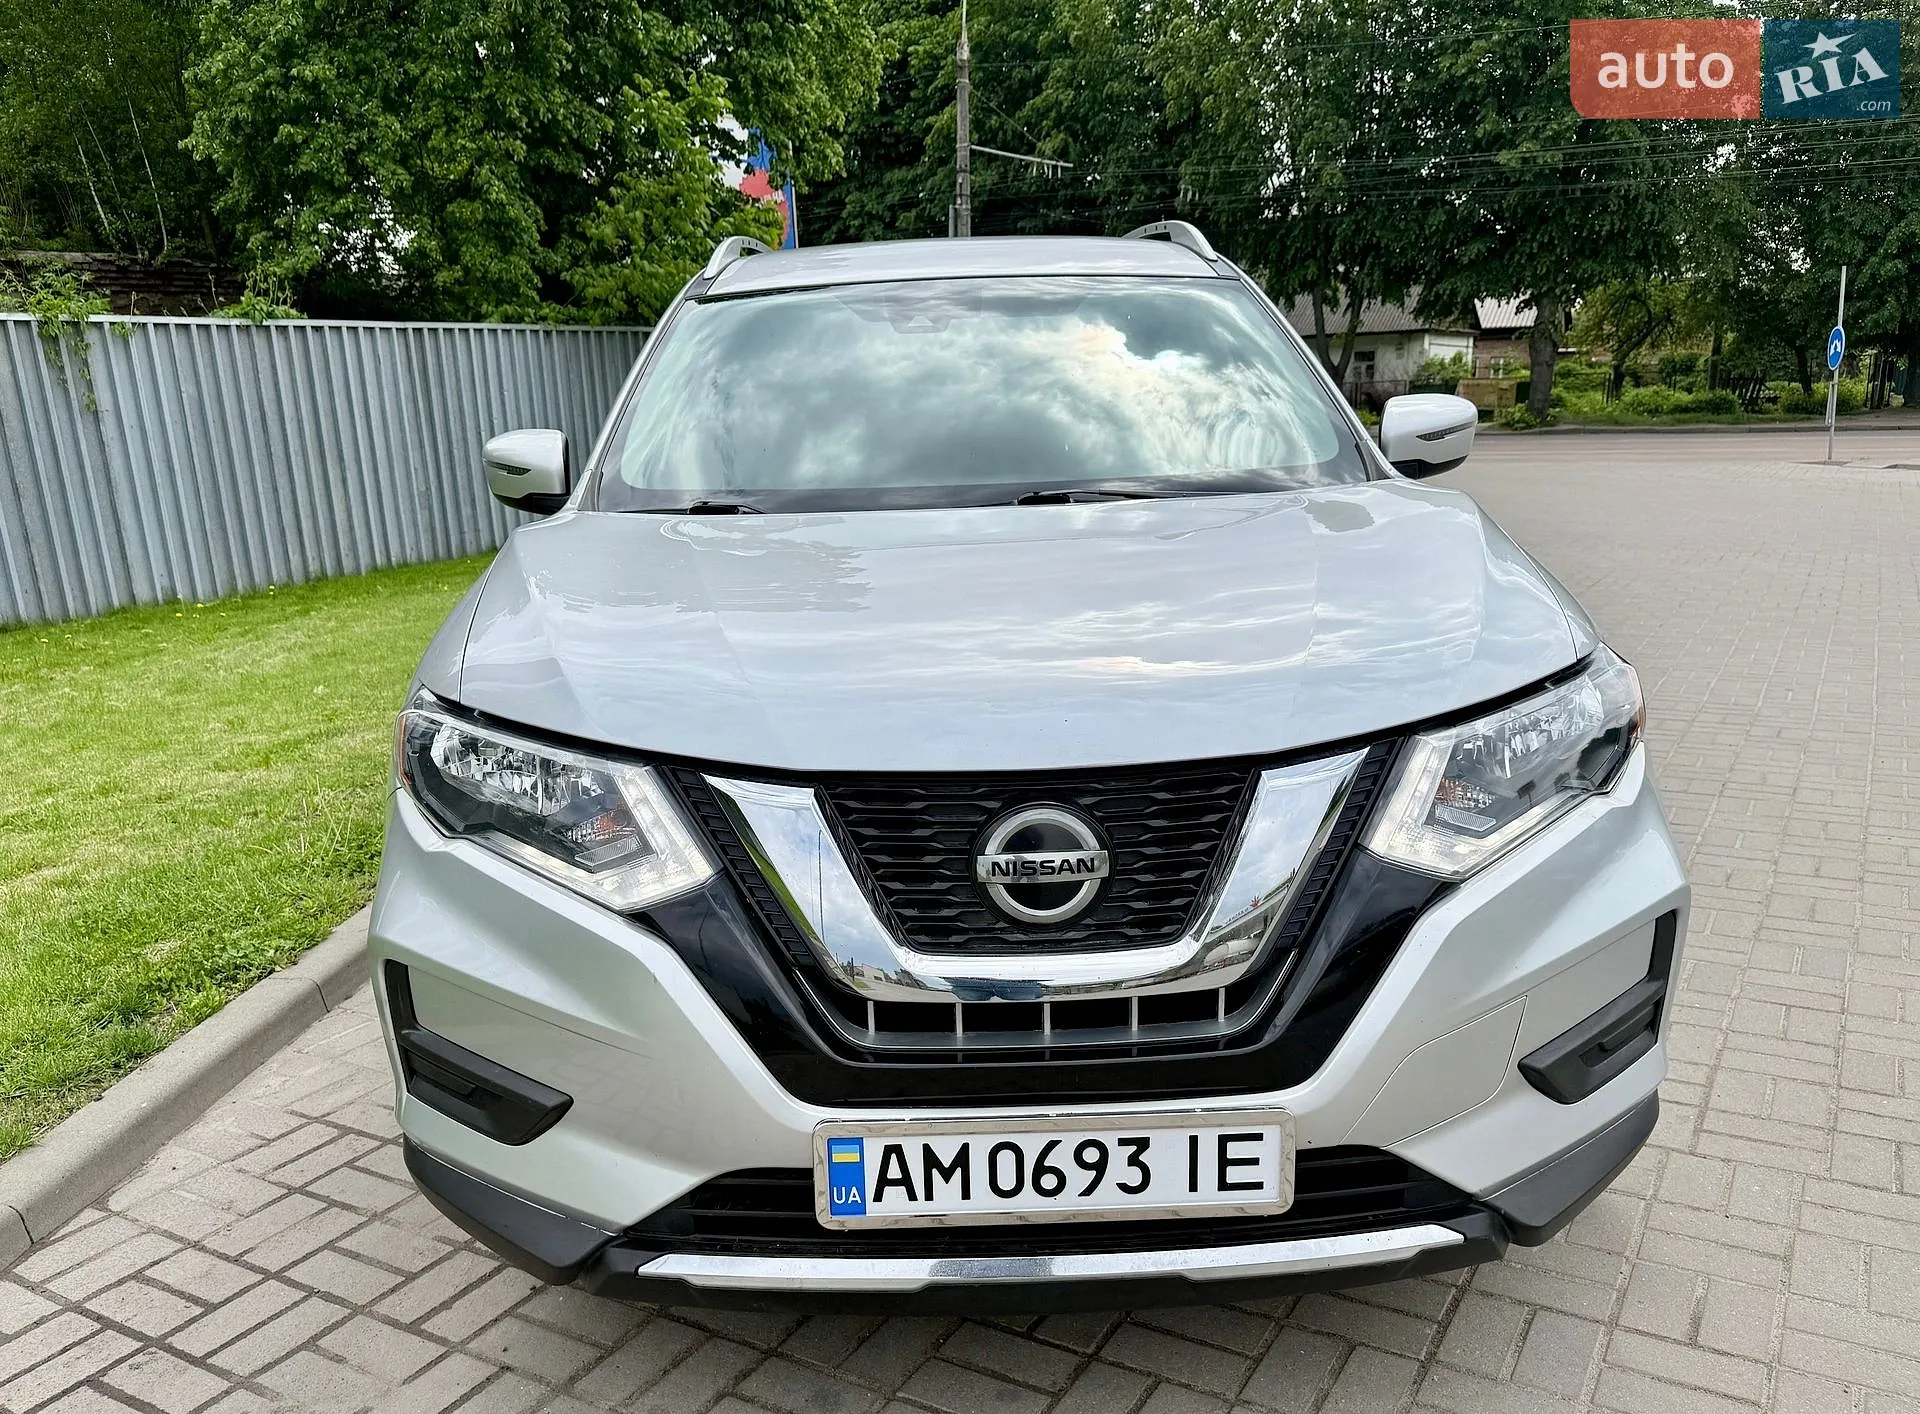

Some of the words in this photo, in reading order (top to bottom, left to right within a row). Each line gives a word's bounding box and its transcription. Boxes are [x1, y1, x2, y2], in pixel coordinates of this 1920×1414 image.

[991, 857, 1095, 877] NISSAN
[872, 1142, 971, 1203] AM
[988, 1136, 1152, 1199] 0693
[1188, 1133, 1265, 1192] IE
[833, 1187, 862, 1205] UA
